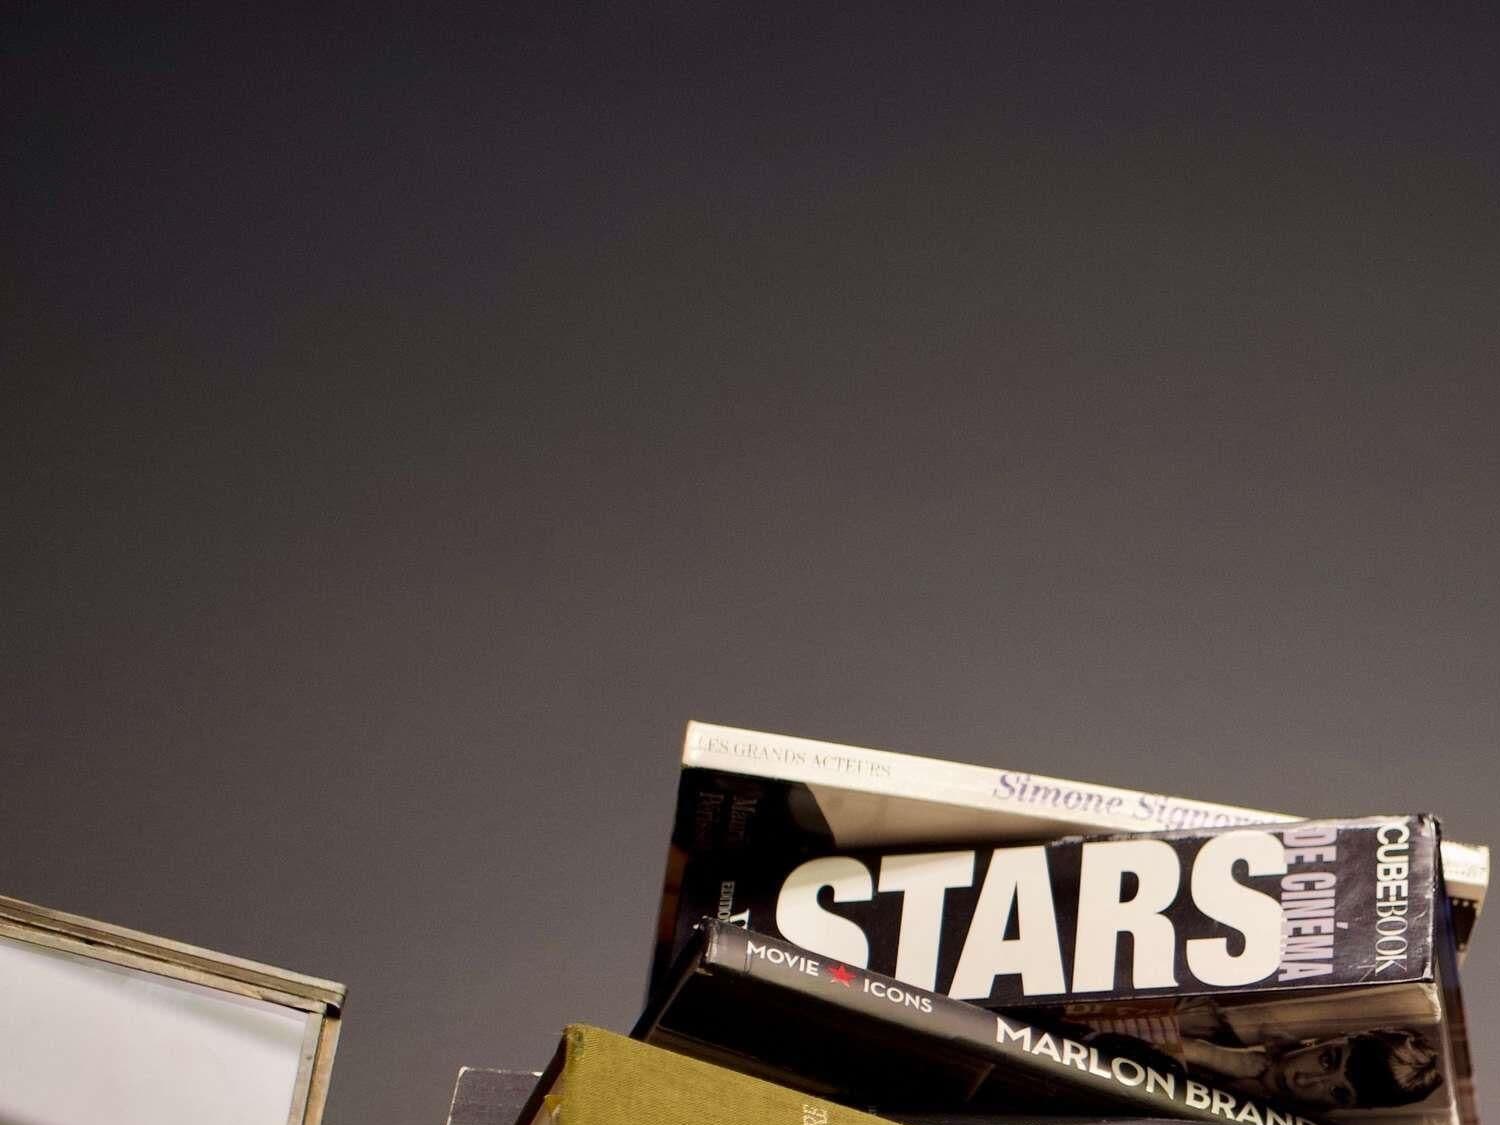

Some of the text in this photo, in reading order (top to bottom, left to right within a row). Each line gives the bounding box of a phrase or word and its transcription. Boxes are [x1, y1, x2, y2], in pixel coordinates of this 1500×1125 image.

[734, 743, 808, 766] GRANDS
[813, 753, 892, 777] ACTEURS
[992, 772, 1123, 811] Simone
[776, 829, 1288, 1001] STARS
[1278, 827, 1349, 982] DE CINÉMA
[1375, 824, 1410, 977] CUBEBOOK
[746, 941, 933, 1014] MOVIE ICONS
[996, 1016, 1176, 1101] MARLON
